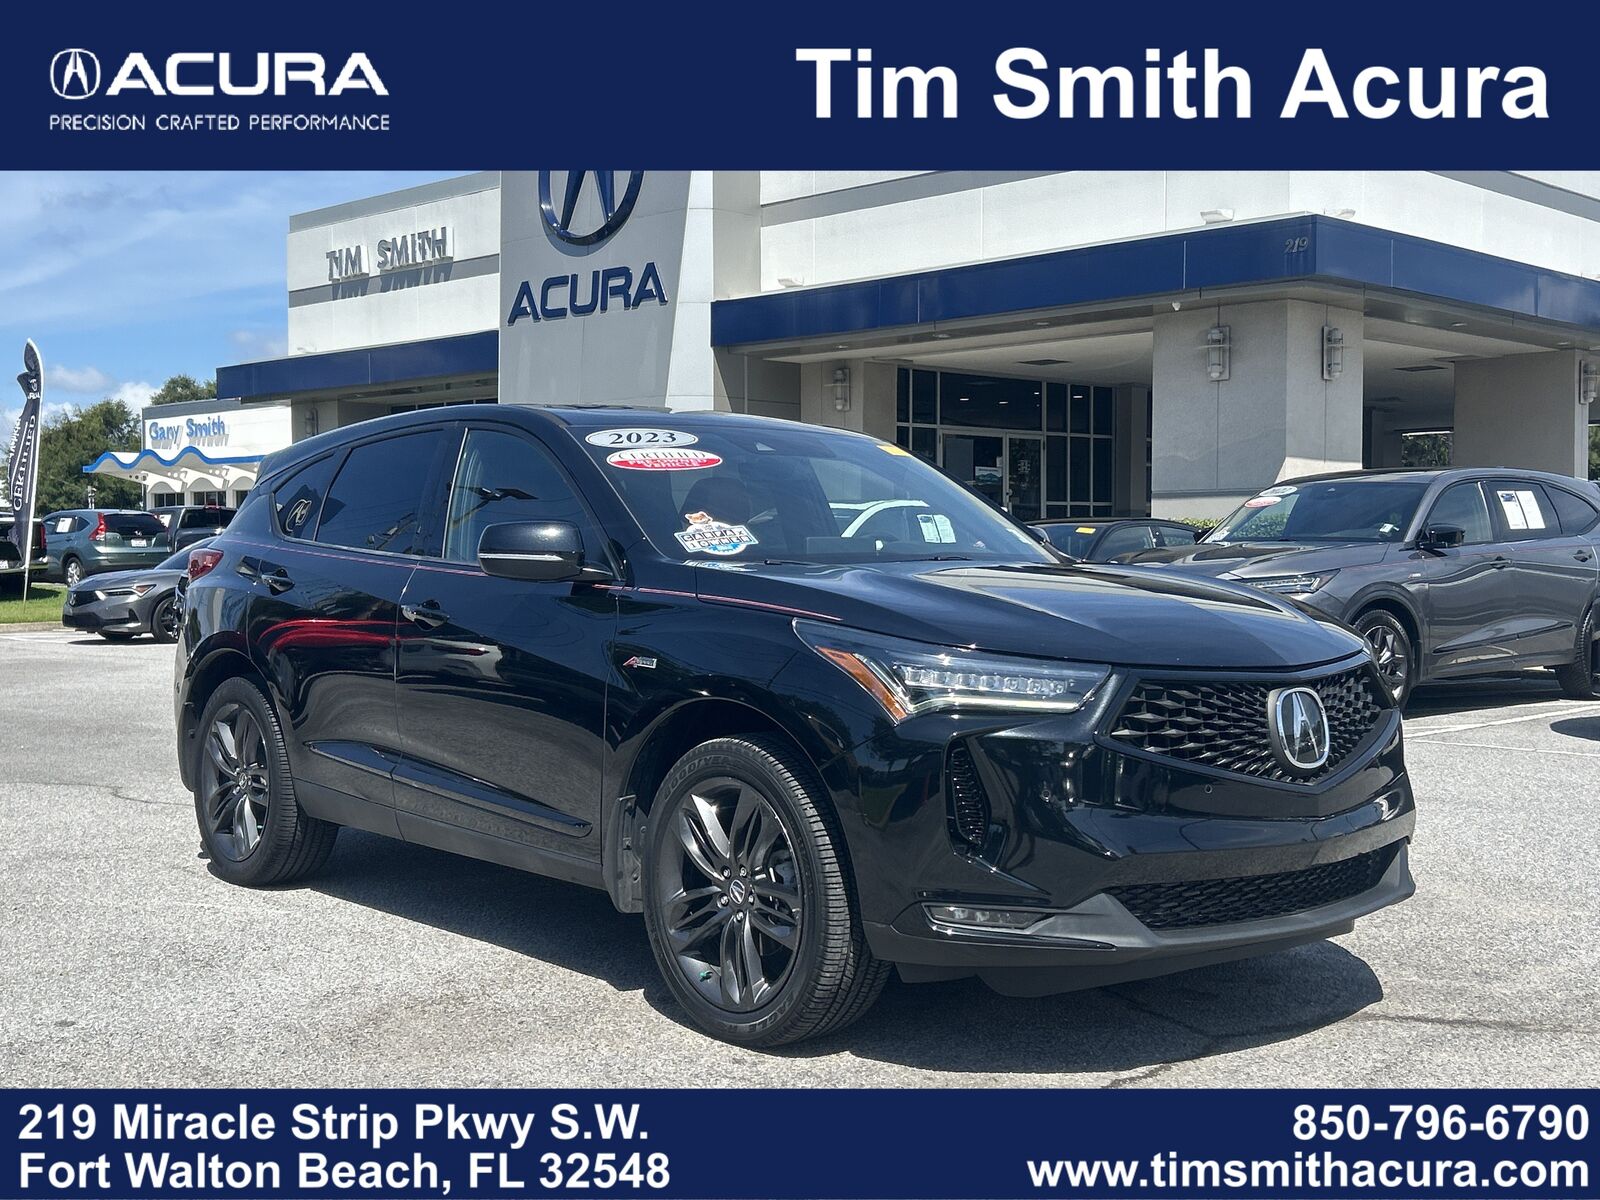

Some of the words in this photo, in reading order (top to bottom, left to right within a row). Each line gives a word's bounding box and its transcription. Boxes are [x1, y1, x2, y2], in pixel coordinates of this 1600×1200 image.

[1284, 236, 1309, 253] 219
[326, 244, 368, 281] TIM
[377, 226, 450, 271] SMITH
[507, 262, 668, 326] ACURA
[149, 421, 180, 445] Gary
[186, 415, 226, 438] Smith
[608, 432, 677, 444] 2023
[682, 528, 744, 542] CARFAX
[698, 535, 753, 548] OWNER
